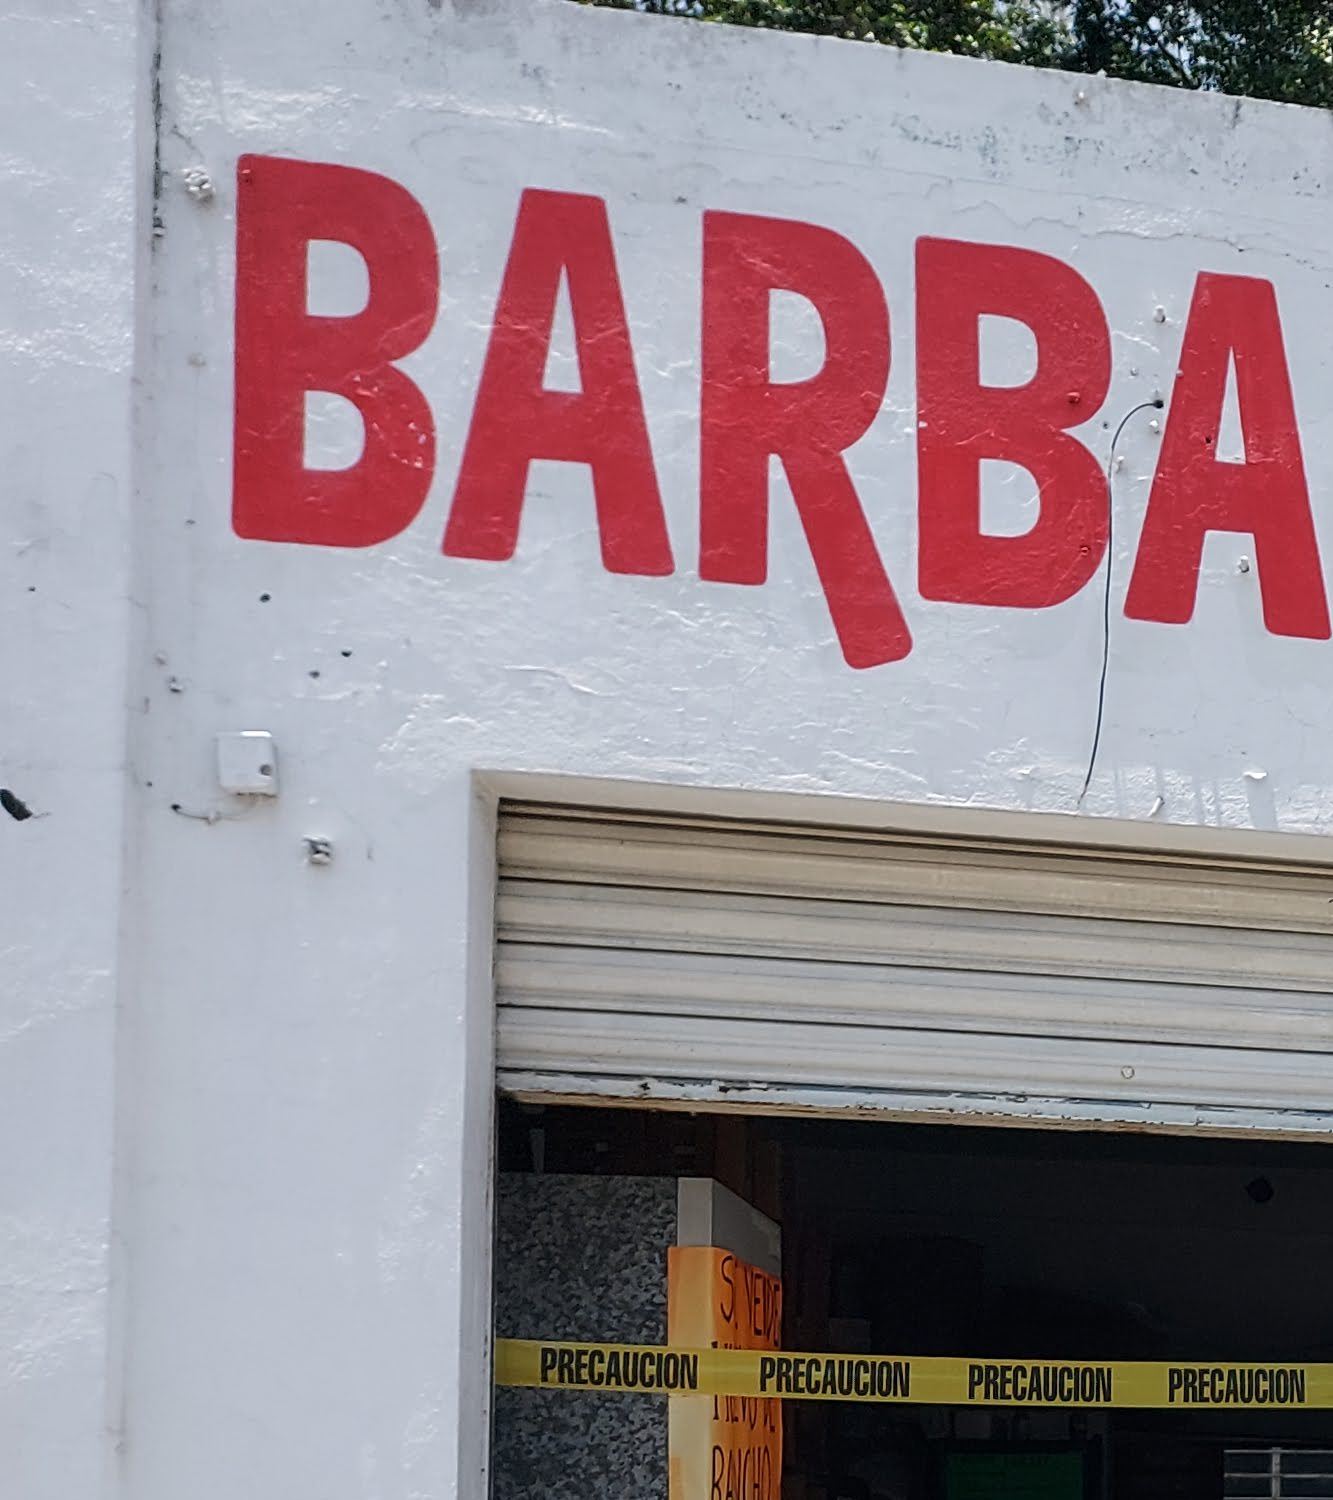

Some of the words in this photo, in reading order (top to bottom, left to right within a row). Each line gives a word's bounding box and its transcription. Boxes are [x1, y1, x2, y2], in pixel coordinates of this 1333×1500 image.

[540, 1348, 698, 1389] PRECAUCION
[759, 1356, 911, 1397] PRECAUCION
[968, 1363, 1113, 1402] PRECAUCION
[1168, 1367, 1306, 1403] PRECAUCION
